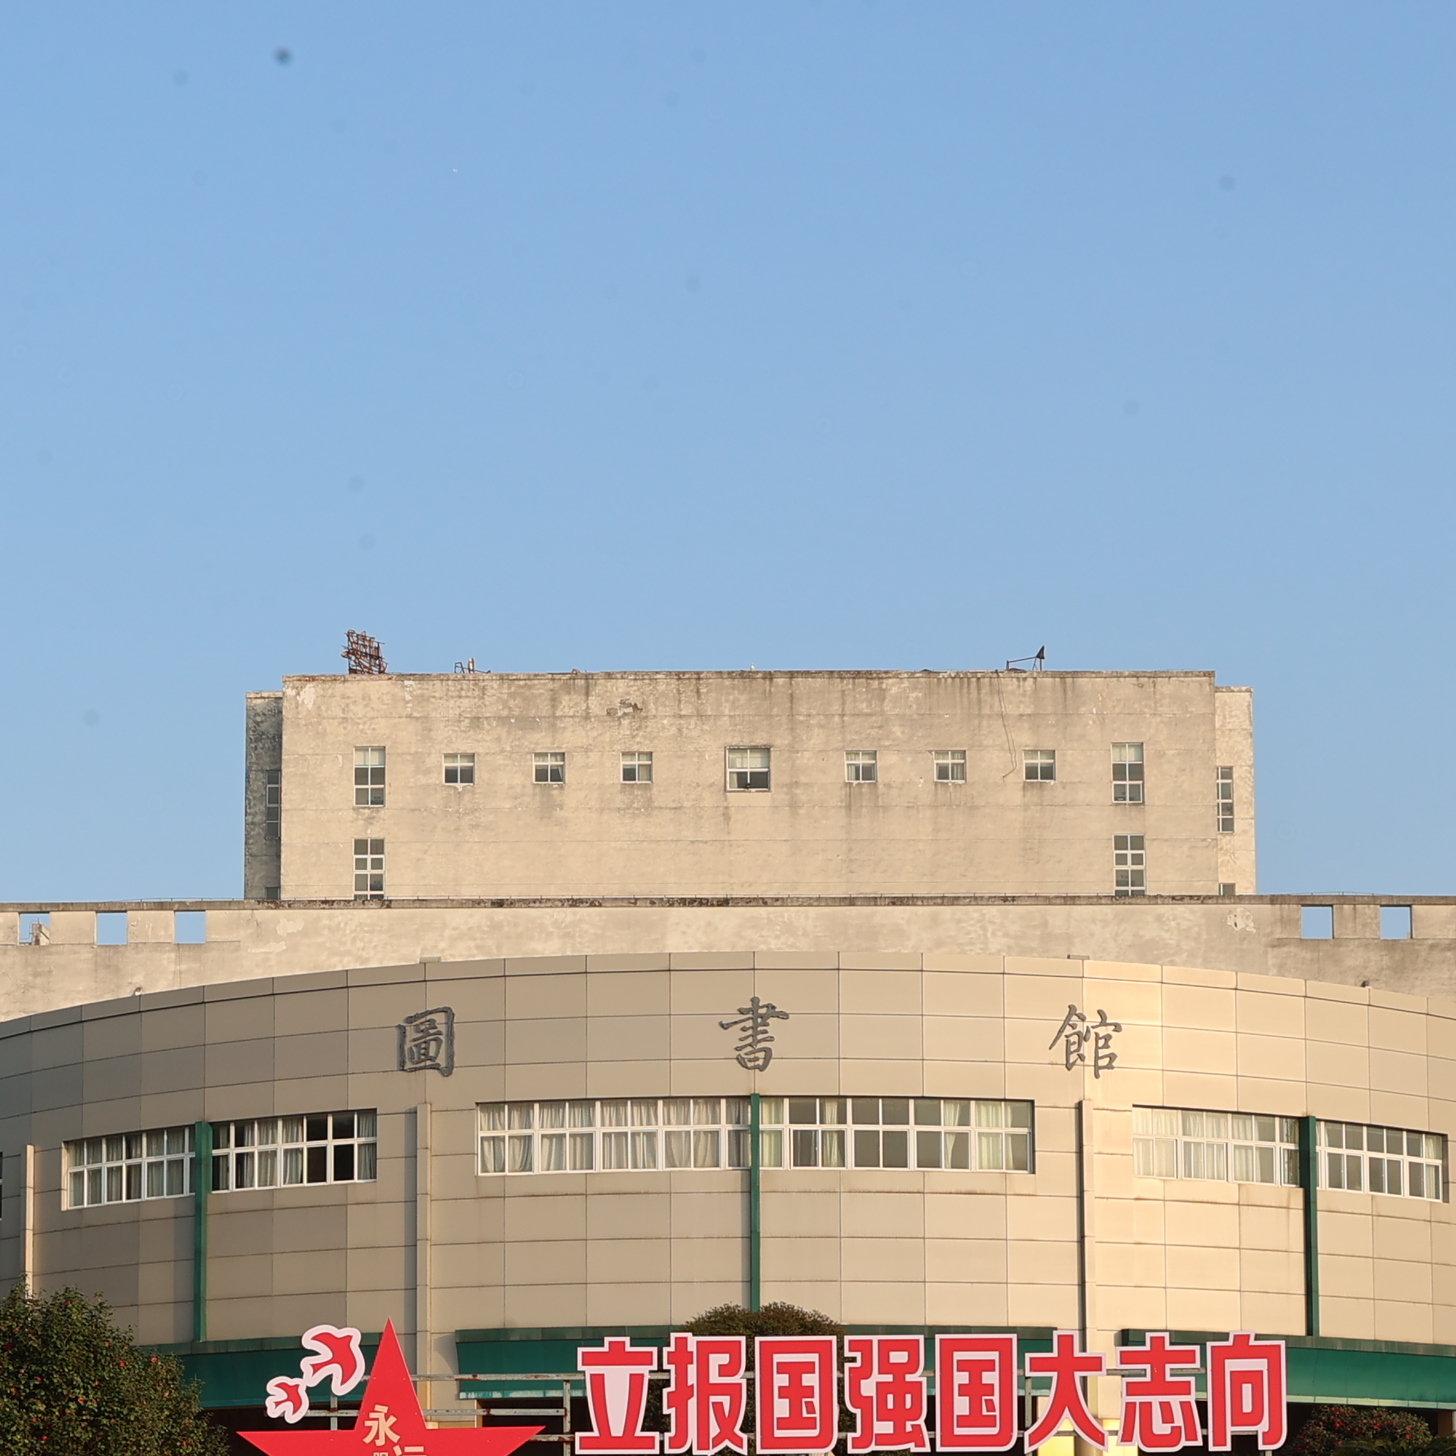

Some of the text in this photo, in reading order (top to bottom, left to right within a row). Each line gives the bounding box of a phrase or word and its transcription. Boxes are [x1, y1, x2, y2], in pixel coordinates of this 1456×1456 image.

[396, 996, 1124, 1079] 圖書館
[575, 1331, 1288, 1455] 立报国强国大志向
